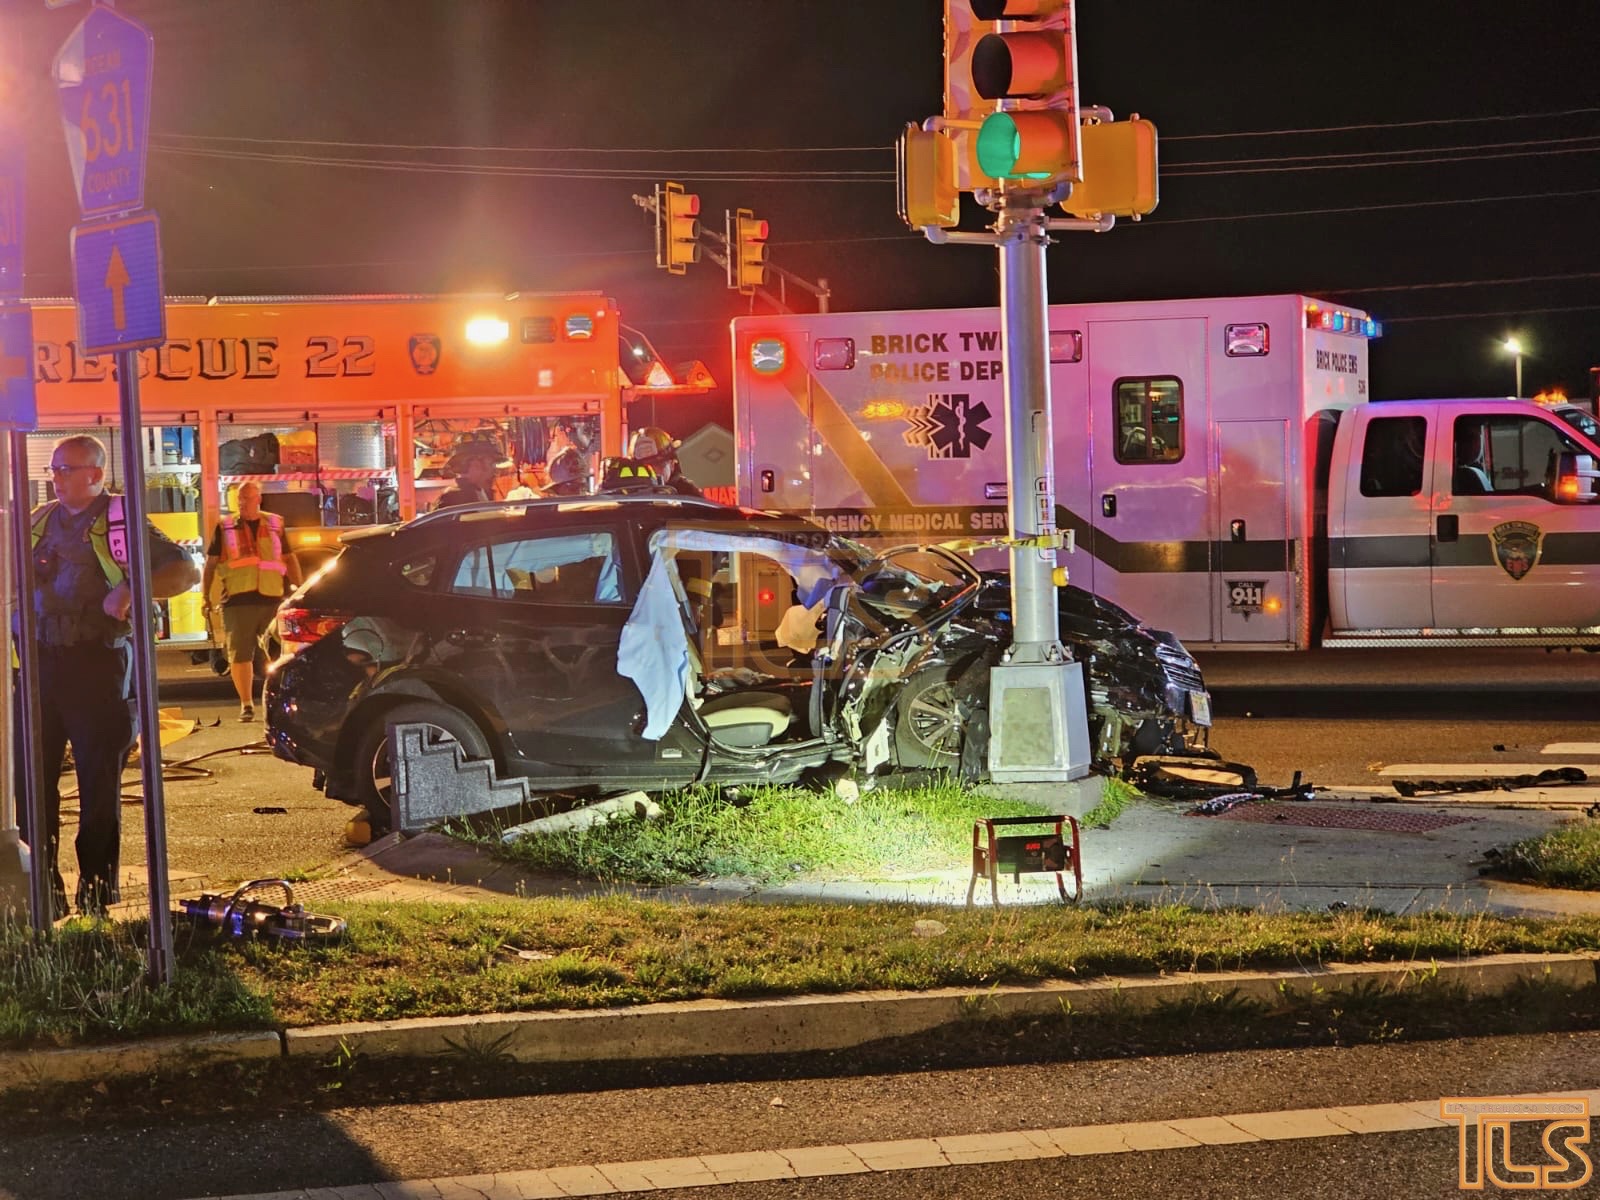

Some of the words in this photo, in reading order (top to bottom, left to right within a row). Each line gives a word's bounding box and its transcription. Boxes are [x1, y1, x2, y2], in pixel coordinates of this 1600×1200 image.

[80, 78, 134, 163] 631
[87, 166, 132, 194] COUNTY
[871, 332, 949, 354] BRICK
[305, 335, 377, 379] 22
[1316, 349, 1330, 371] BRICK
[1332, 352, 1348, 373] POLICE
[1348, 354, 1358, 374] EMS
[870, 361, 950, 384] POLICE
[890, 512, 964, 530] MEDICAL
